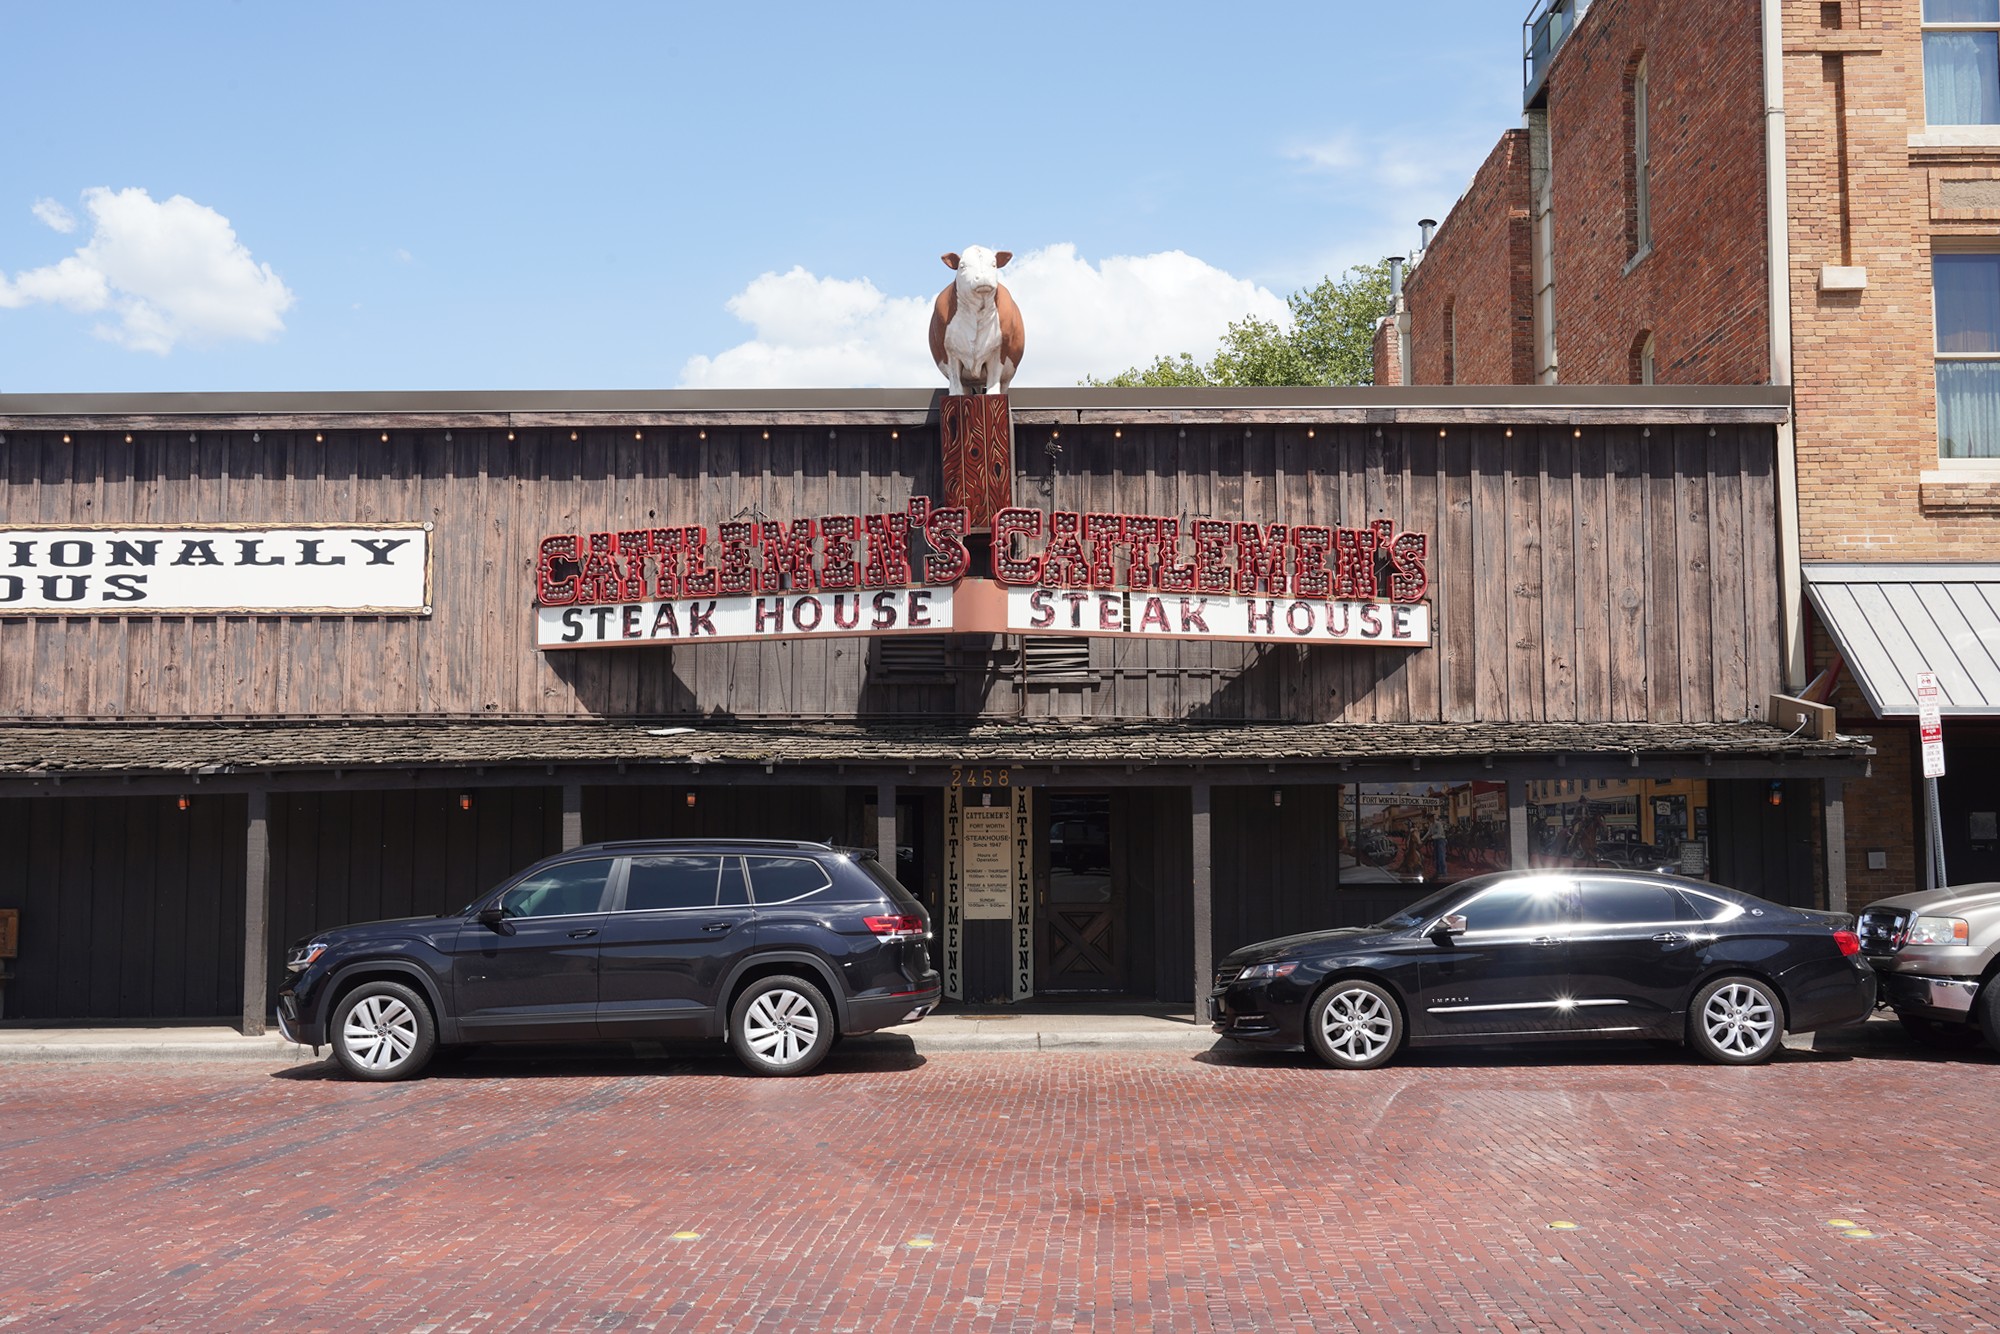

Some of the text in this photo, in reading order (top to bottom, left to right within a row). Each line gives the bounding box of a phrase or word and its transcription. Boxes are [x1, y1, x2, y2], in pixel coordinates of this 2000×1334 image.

[8, 538, 411, 567] IONALLY
[536, 496, 970, 605] CATTLEMEN'S
[990, 507, 1429, 604] CATTLEMEN'S
[561, 591, 932, 642] STEAK HOUSE
[1030, 589, 1412, 640] STEAK HOUSE
[951, 769, 1009, 787] 2458
[1362, 796, 1377, 804] FORT
[1379, 796, 1398, 804] WORTH
[1401, 797, 1419, 805] STOCK
[966, 811, 1010, 820] CATTLEMEN'S
[948, 786, 959, 993] ATTLEMENS
[1017, 786, 1030, 993] ATTLEMENS
